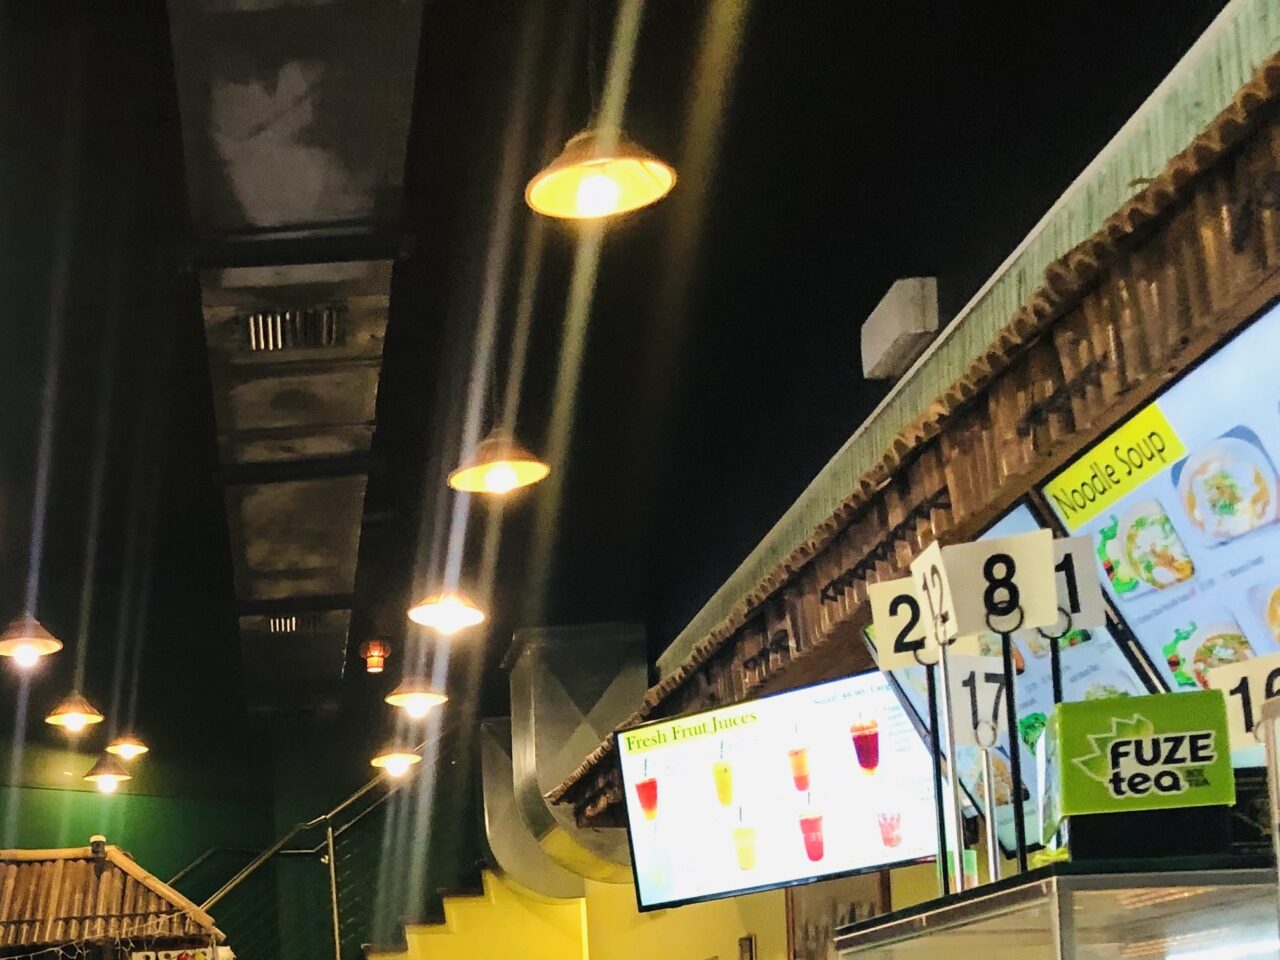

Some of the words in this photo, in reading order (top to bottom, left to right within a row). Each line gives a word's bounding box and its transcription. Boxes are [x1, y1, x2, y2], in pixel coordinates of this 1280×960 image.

[1052, 462, 1120, 519] Noodle
[1114, 431, 1167, 477] Soup
[922, 563, 950, 624] 12
[983, 553, 1020, 616] 8
[888, 594, 926, 653] 2
[961, 670, 1007, 730] 17
[626, 730, 668, 751] Fresh
[671, 720, 709, 742] Fruit
[710, 711, 758, 735] Juices
[1110, 732, 1214, 770] FUZE
[1108, 770, 1183, 796] tea
